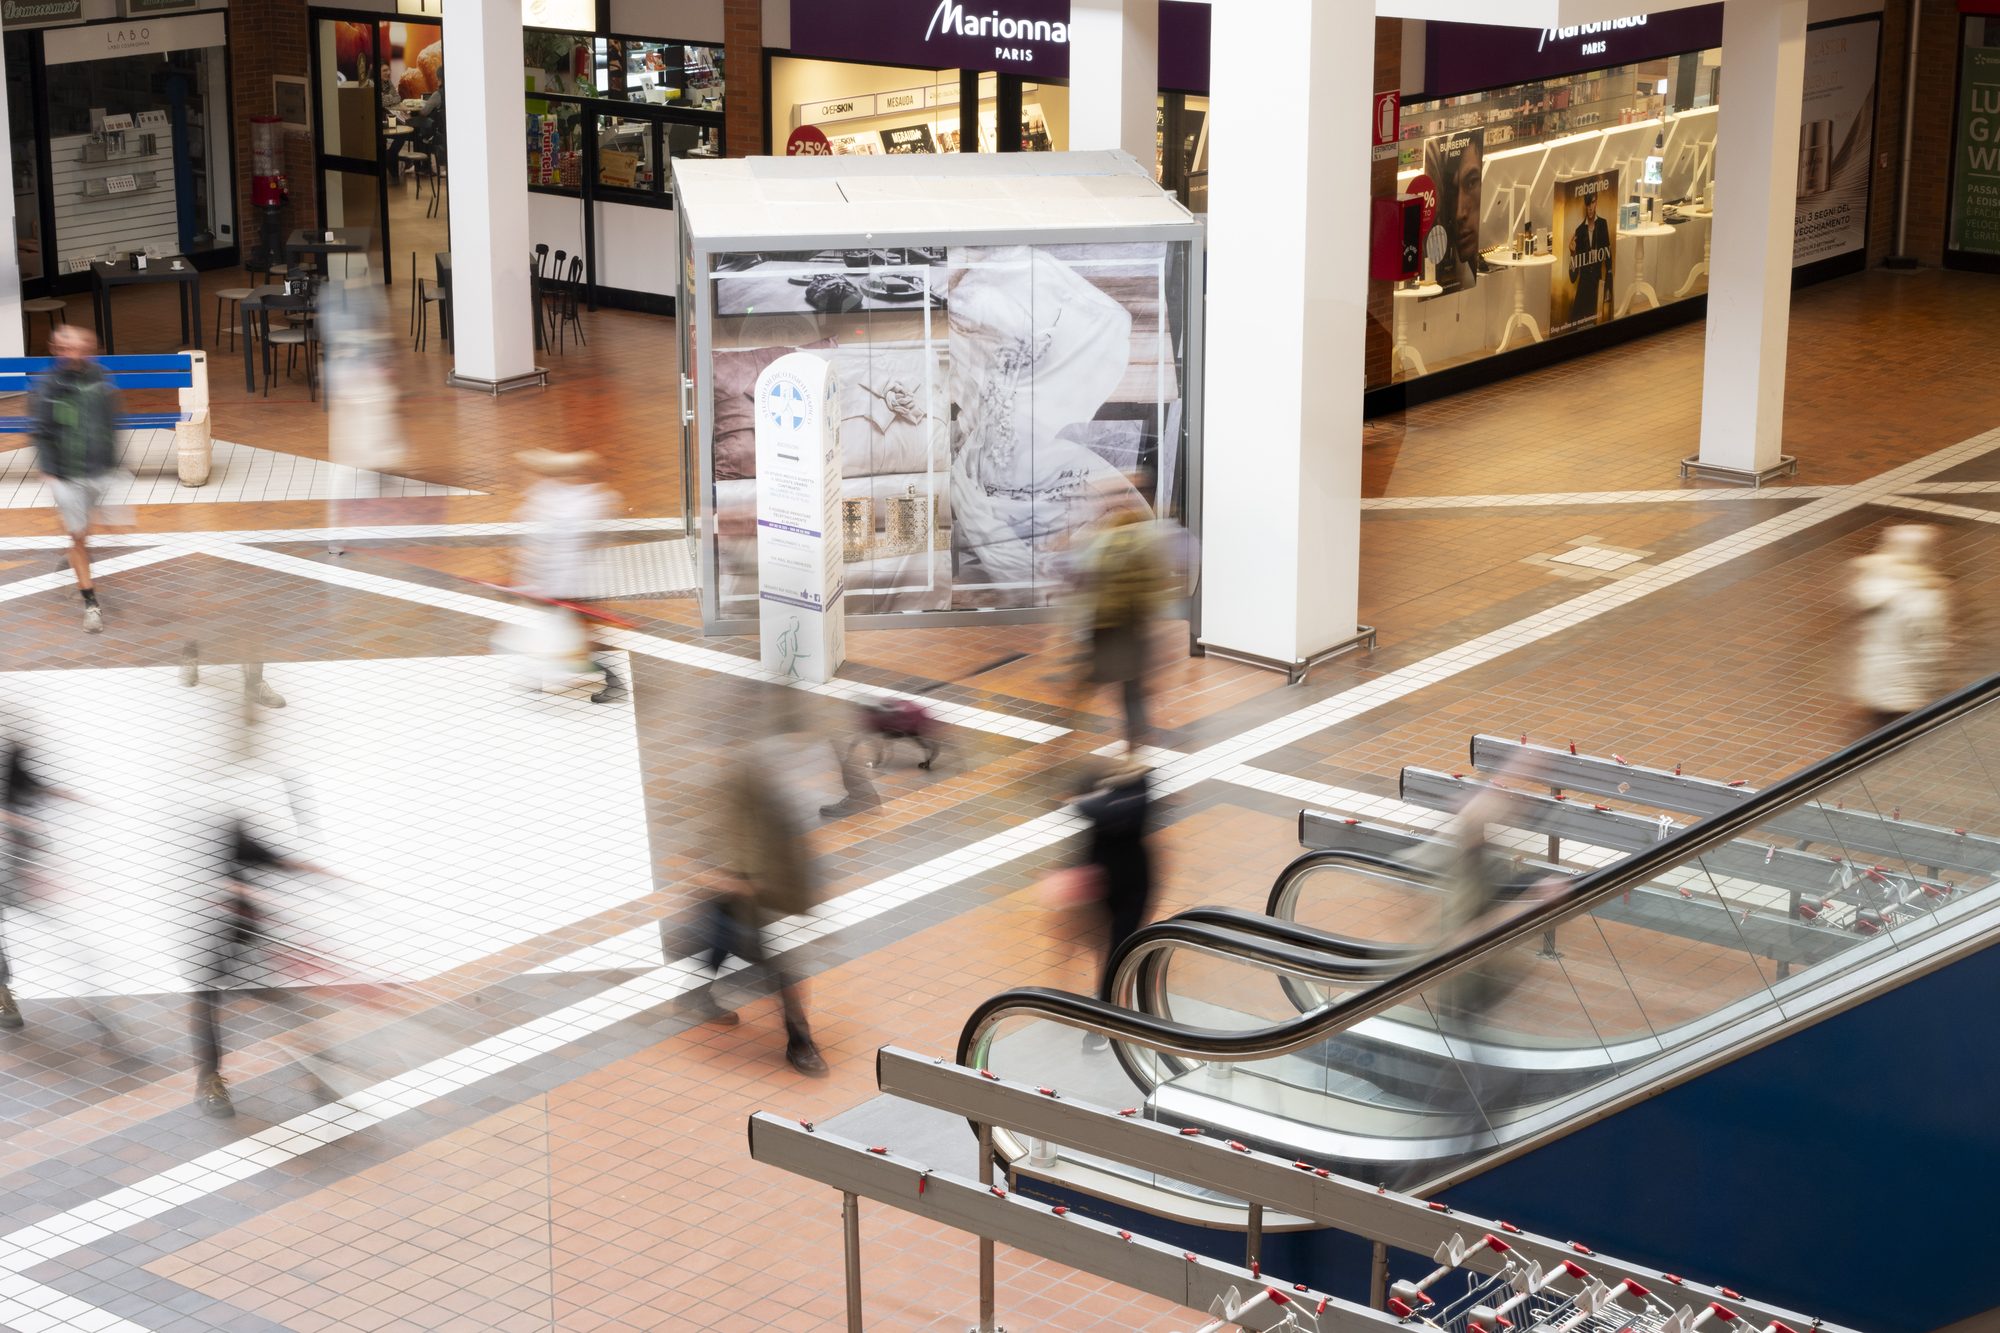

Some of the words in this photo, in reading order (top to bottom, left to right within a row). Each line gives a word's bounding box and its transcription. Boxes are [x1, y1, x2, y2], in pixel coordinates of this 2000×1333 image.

[924, 0, 1072, 43] Marionna
[107, 28, 150, 43] LABO
[994, 46, 1034, 62] PARIS
[1581, 40, 1607, 56] PARIS
[821, 102, 854, 117] OVERSKIN
[886, 95, 914, 109] MESAUDA
[541, 120, 555, 186] Fruit-tella
[1438, 138, 1470, 153] BURBERRY
[1574, 177, 1610, 198] rabanne
[1967, 183, 1998, 196] PASSA
[1807, 211, 1813, 222] 3
[1814, 207, 1836, 220] SEGNI
[1570, 246, 1612, 271] MILLION
